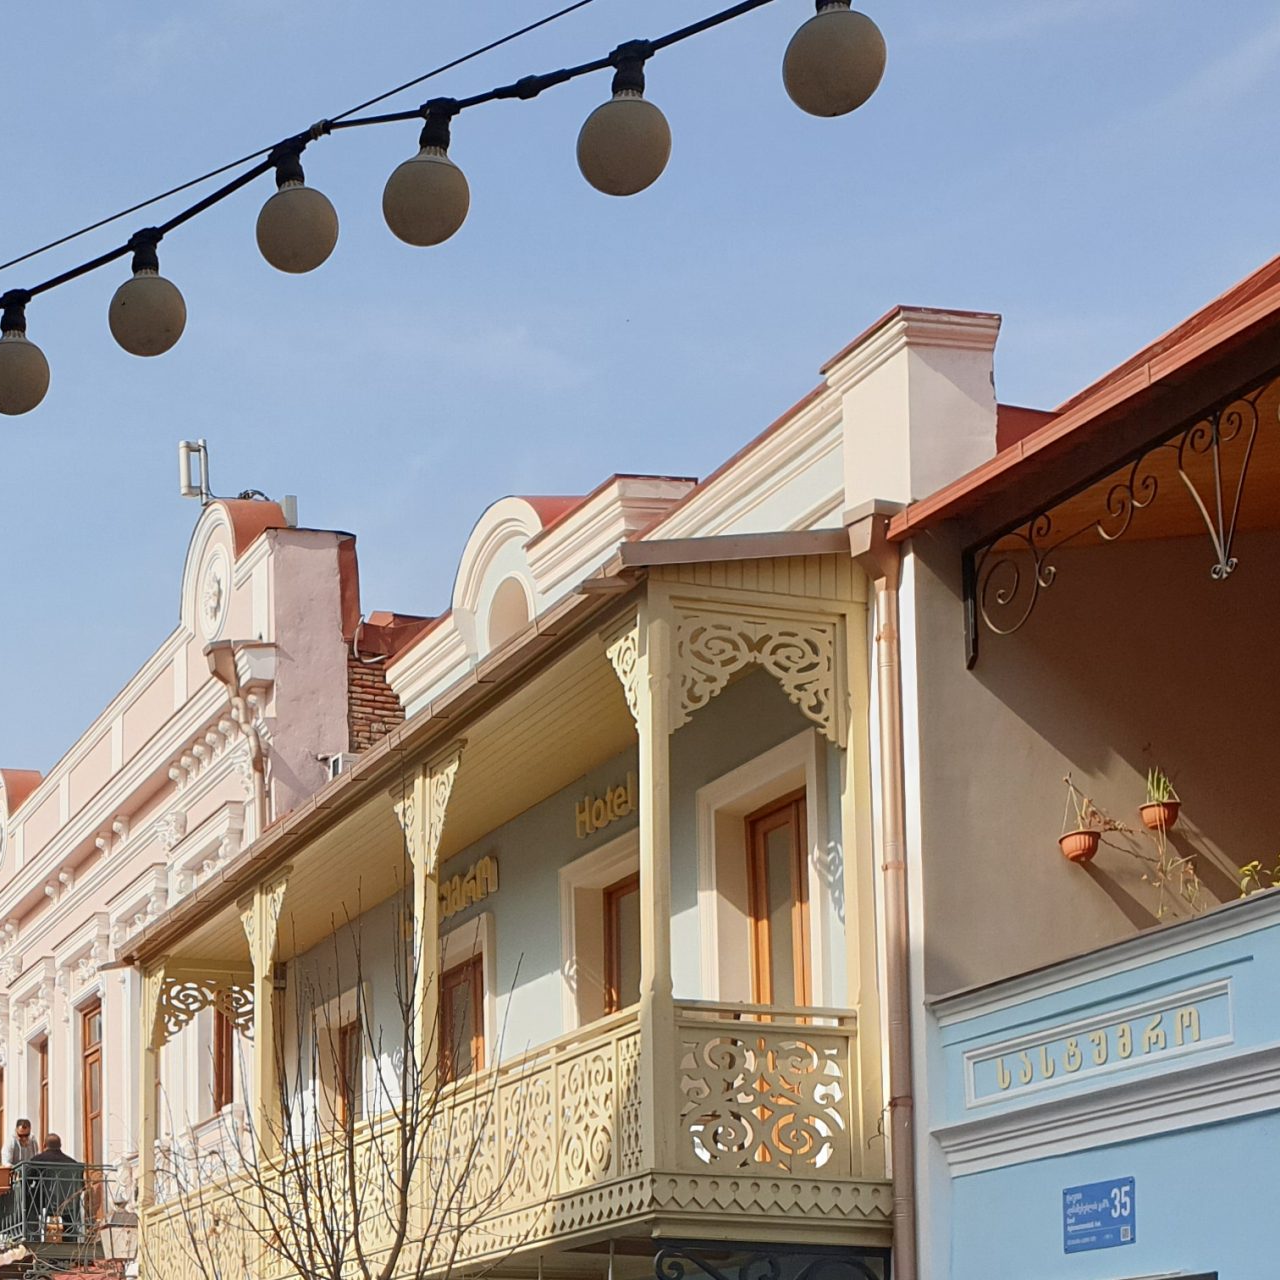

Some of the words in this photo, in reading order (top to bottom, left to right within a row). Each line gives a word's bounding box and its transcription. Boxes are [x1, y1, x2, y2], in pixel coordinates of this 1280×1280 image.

[575, 771, 636, 839] Hotel
[996, 1007, 1200, 1089] სასტუმრო
[1111, 1185, 1130, 1218] 35
